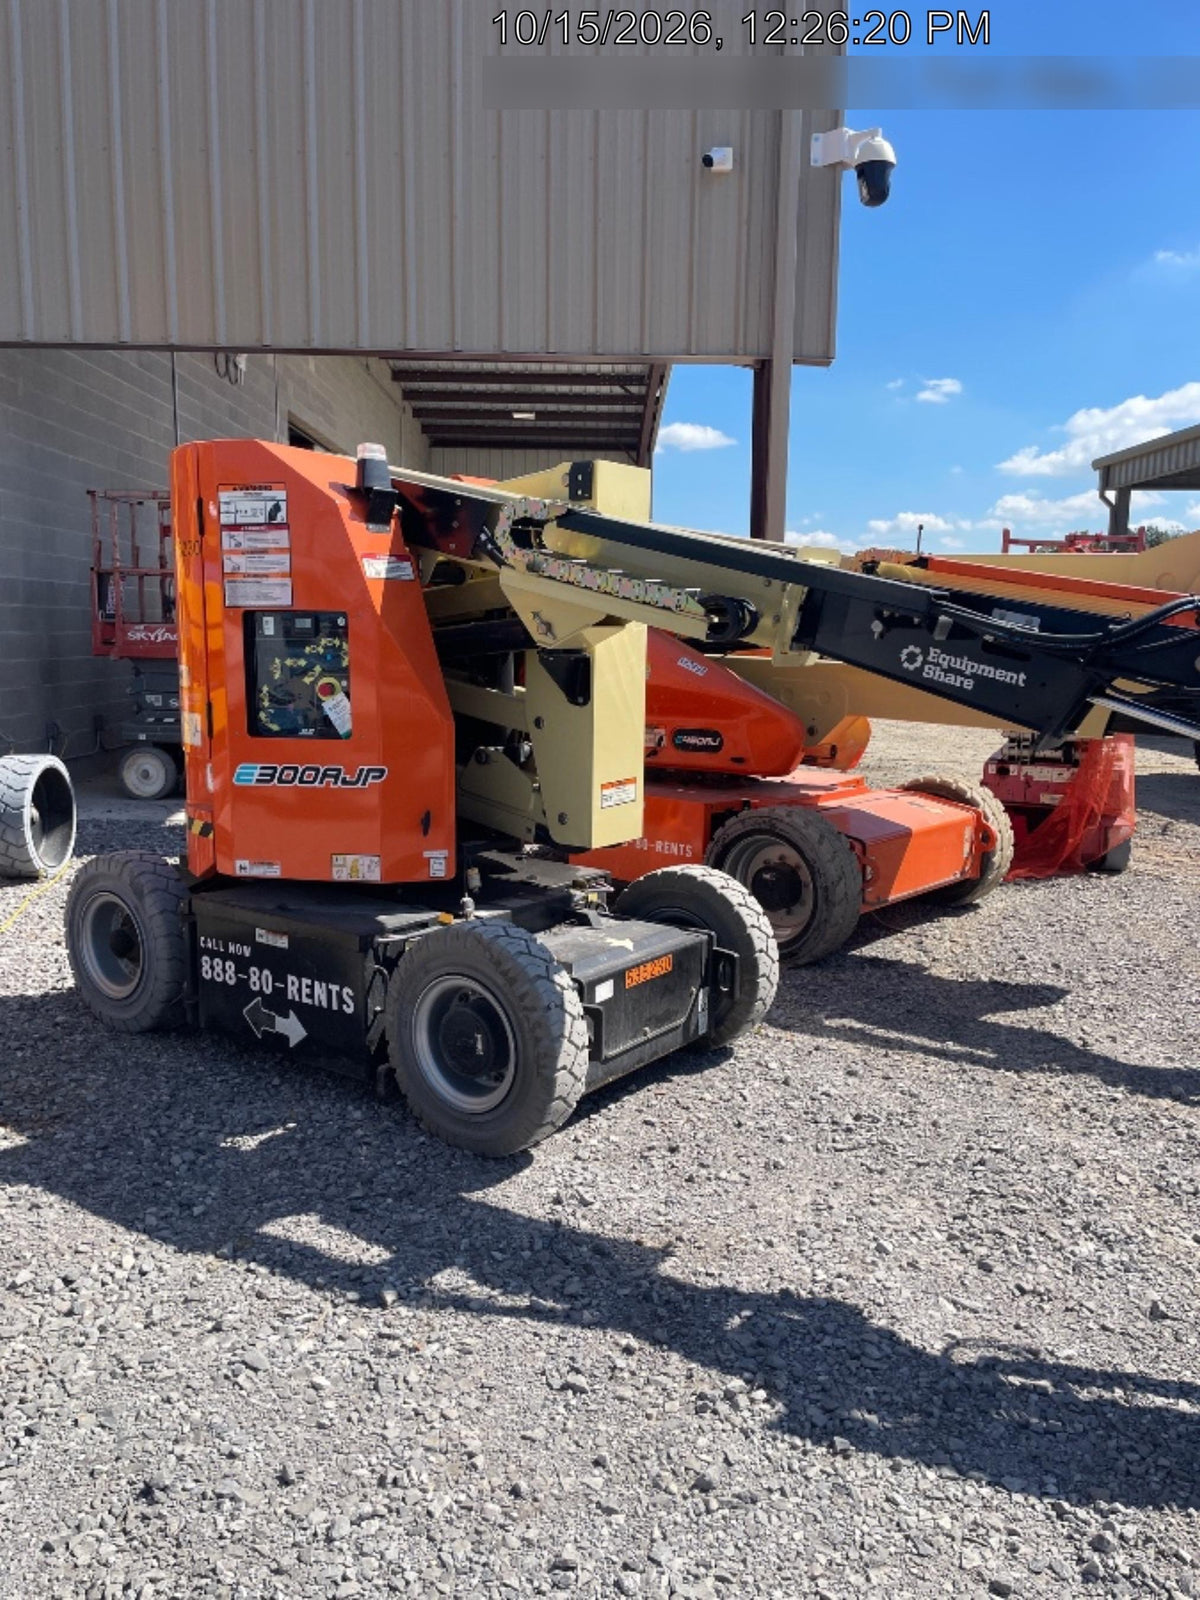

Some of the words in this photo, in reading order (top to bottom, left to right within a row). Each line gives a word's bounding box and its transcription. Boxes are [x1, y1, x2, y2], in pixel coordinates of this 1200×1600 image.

[922, 664, 975, 690] Share
[927, 646, 1027, 687] Equipment
[232, 763, 388, 788] E300AJP
[200, 936, 225, 952] CALL
[228, 941, 251, 957] NOW
[201, 955, 355, 1014] 888-80-RENTS
